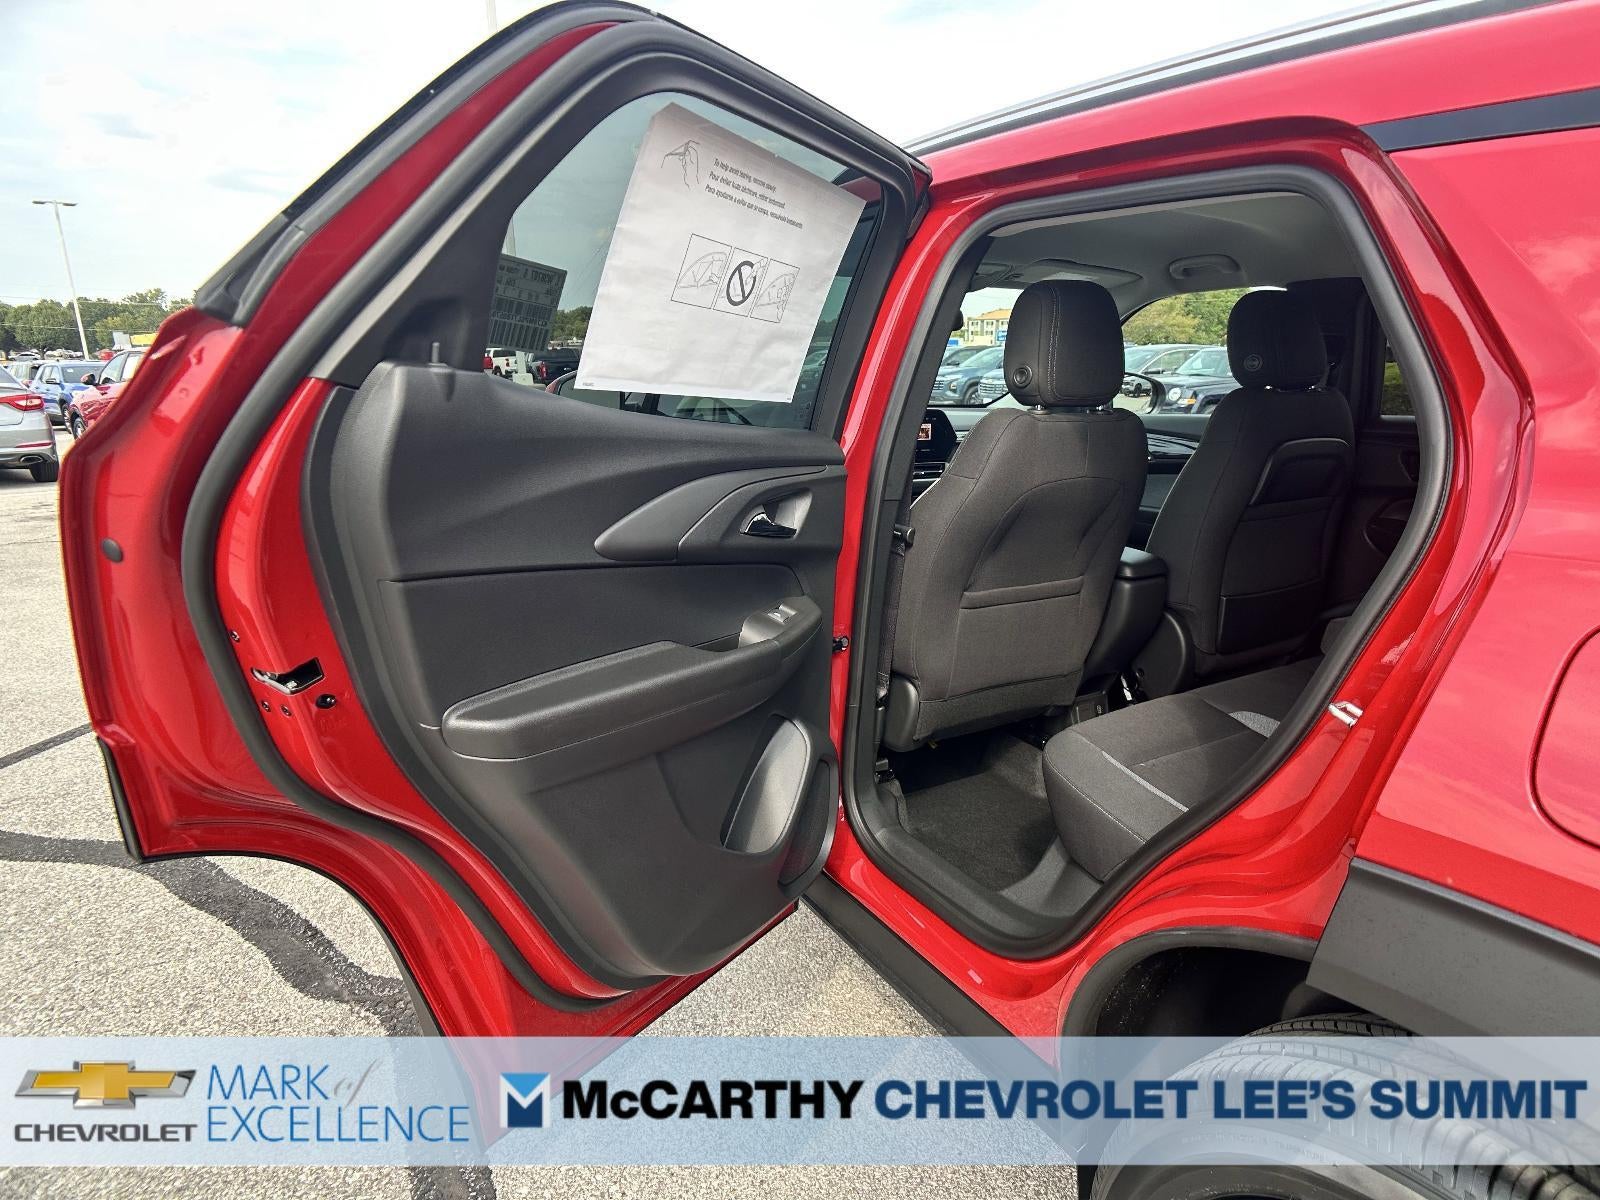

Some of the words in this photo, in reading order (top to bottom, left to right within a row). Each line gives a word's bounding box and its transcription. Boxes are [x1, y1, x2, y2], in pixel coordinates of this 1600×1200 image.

[714, 158, 719, 168] To
[720, 161, 729, 172] help
[709, 171, 719, 181] Pour
[705, 184, 715, 194] Para
